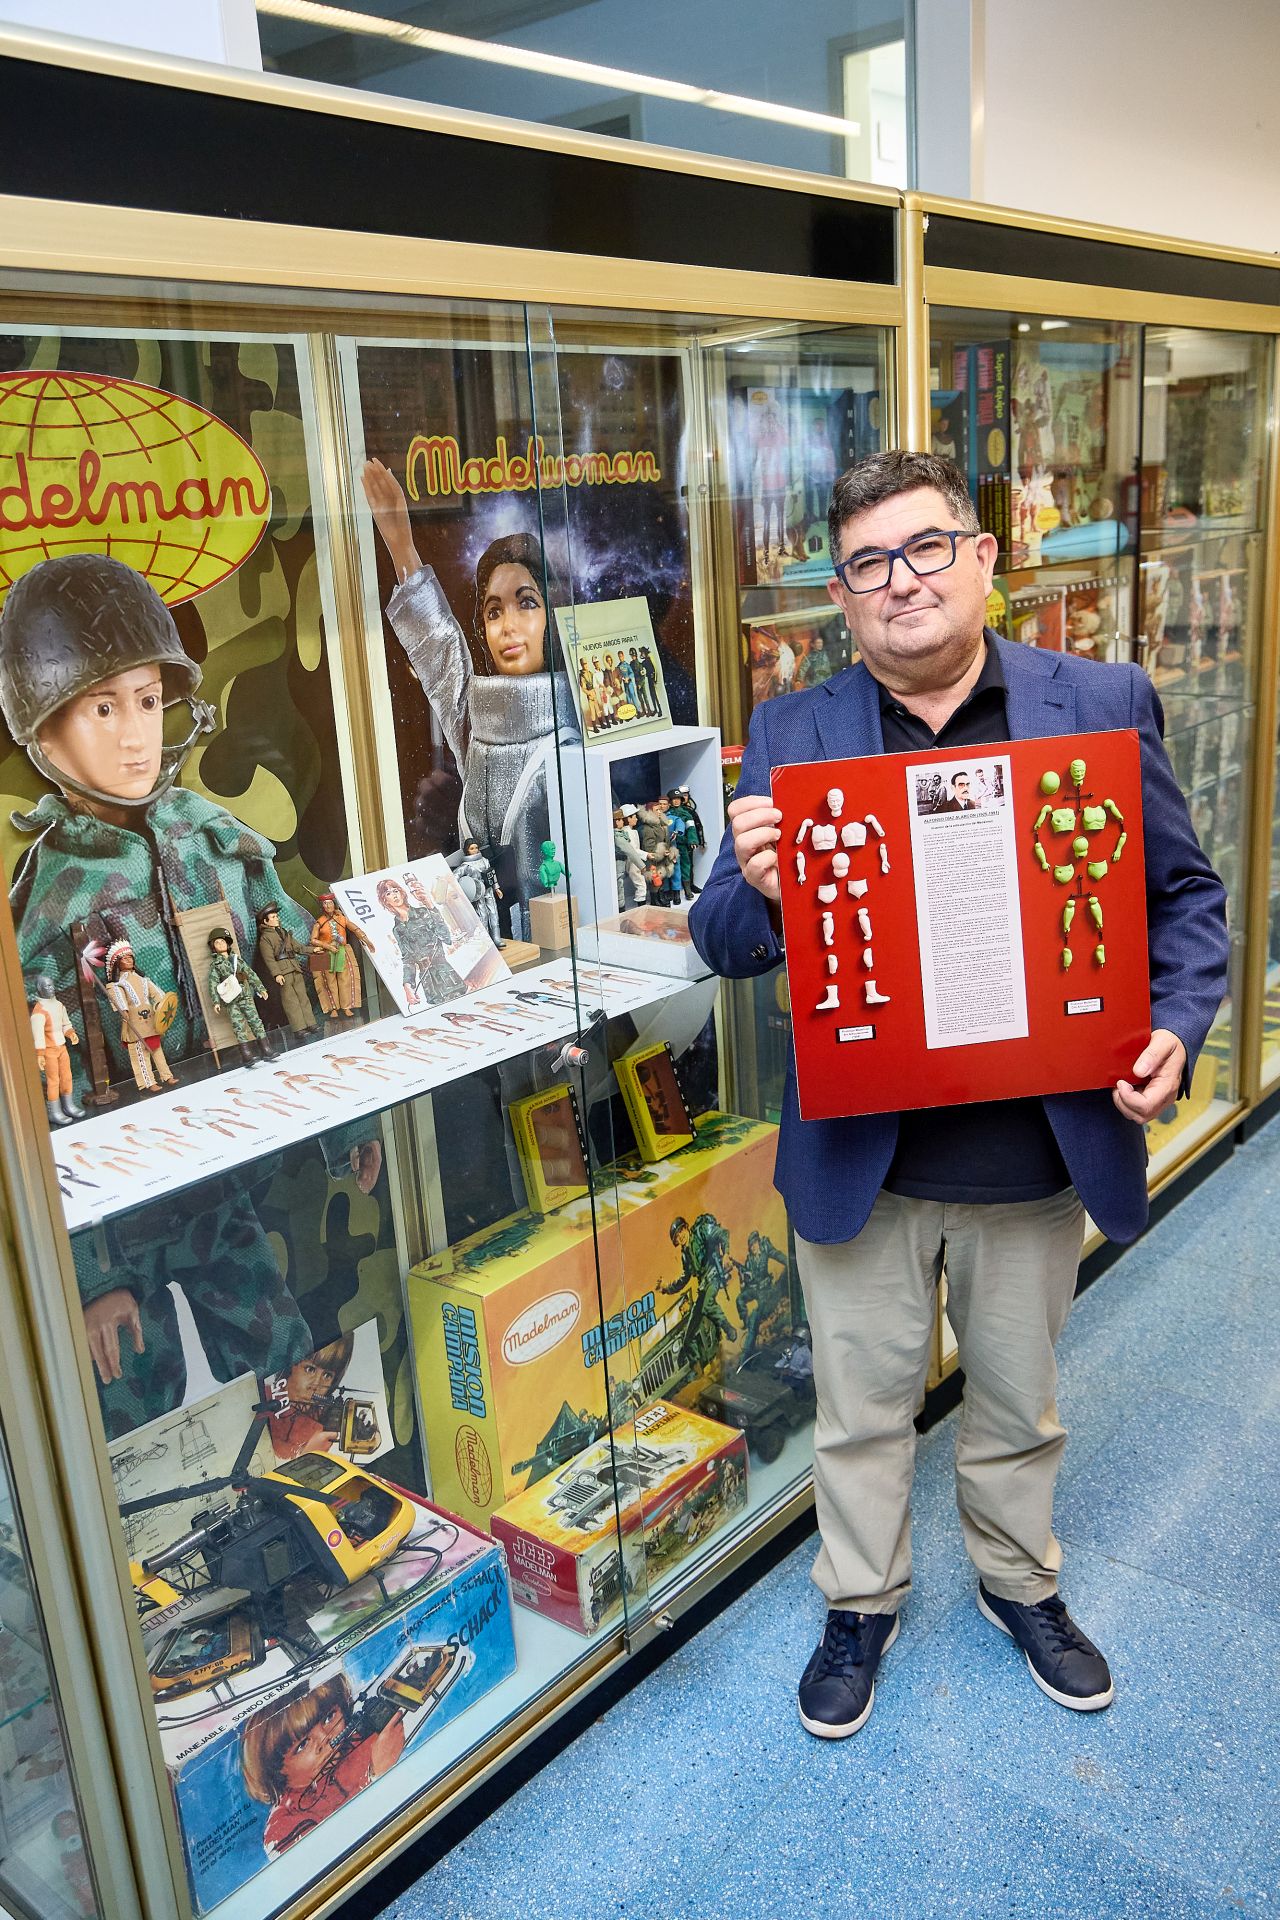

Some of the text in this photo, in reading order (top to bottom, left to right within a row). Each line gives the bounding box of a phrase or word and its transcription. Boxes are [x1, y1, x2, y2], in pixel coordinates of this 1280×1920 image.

[406, 435, 661, 501] Madelwoman
[583, 641, 602, 652] NUEVOS
[603, 638, 621, 648] AMIGOS
[621, 635, 634, 644] PARA
[344, 890, 376, 924] 1977
[504, 1302, 579, 1352] Madelman
[634, 1406, 668, 1432] JEEP
[642, 1411, 681, 1436] MADELMAN
[466, 1431, 481, 1504] Madelman
[512, 1536, 555, 1570] JEEP
[513, 1554, 557, 1582] MADELMAN
[175, 1724, 227, 1761] MANEJABLE
[231, 1700, 264, 1723] SONIDO
[263, 1690, 276, 1702] DE
[465, 1546, 486, 1562] PILAS
[213, 1820, 228, 1835] vivir
[228, 1809, 242, 1822] con
[243, 1802, 251, 1811] tu
[197, 1818, 241, 1858] MADELMAN
[199, 1816, 259, 1867] nuevas aventuras
